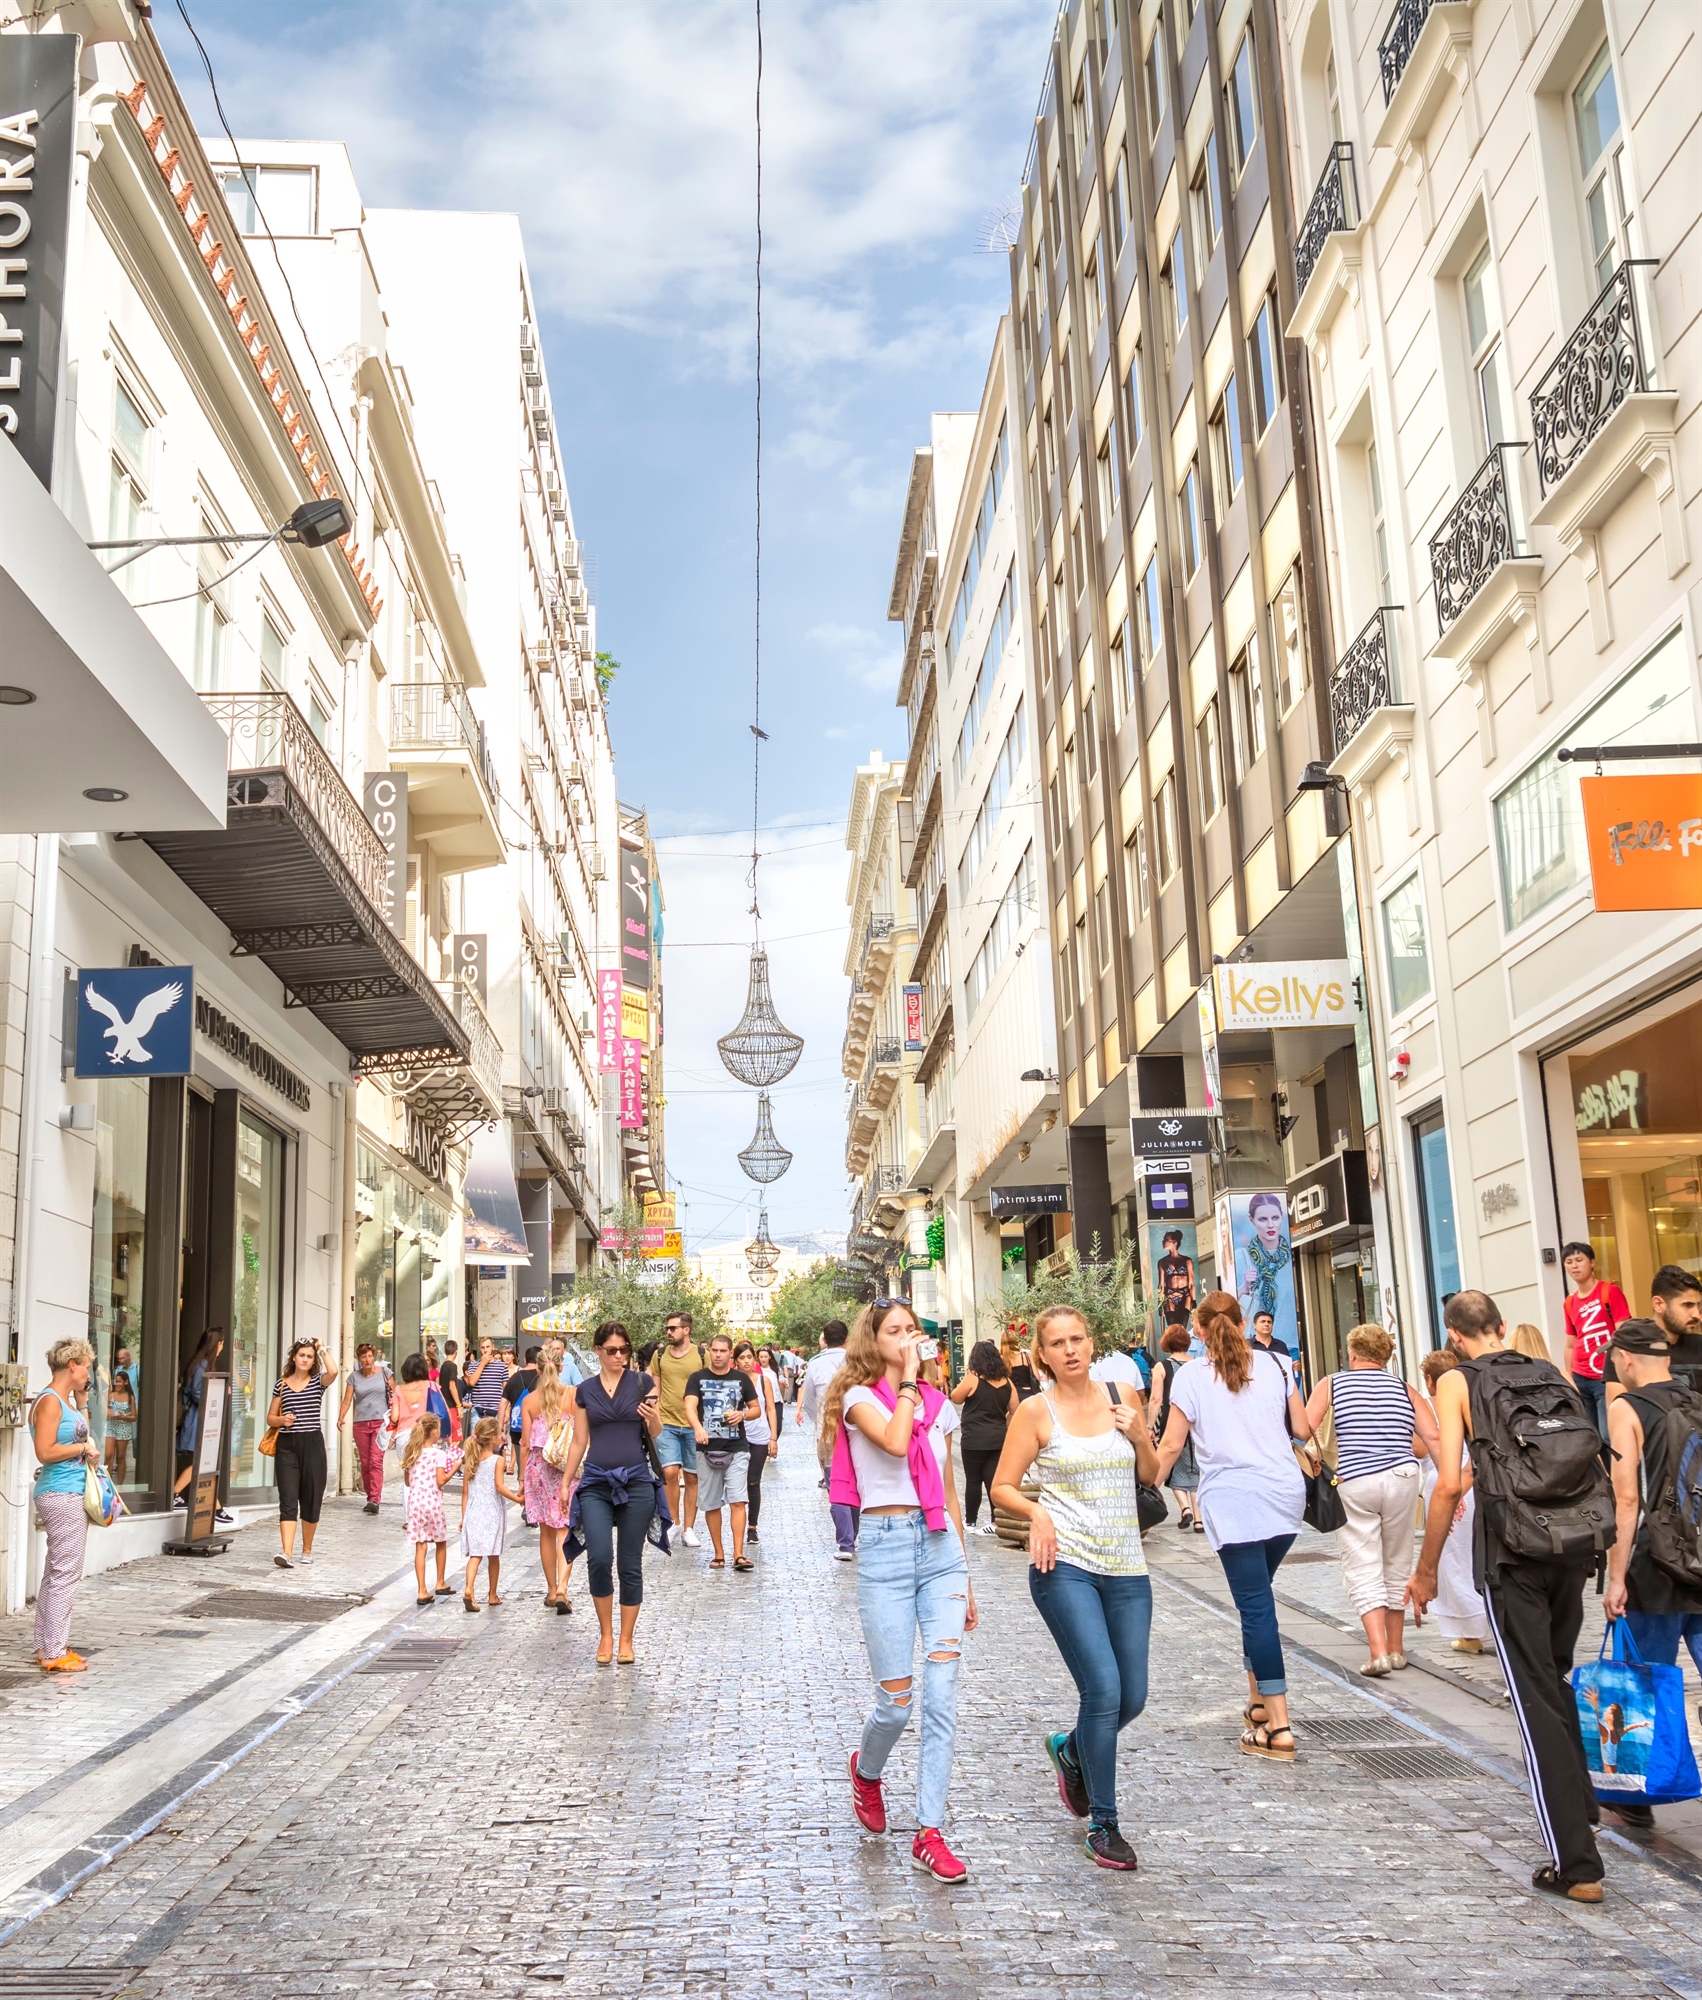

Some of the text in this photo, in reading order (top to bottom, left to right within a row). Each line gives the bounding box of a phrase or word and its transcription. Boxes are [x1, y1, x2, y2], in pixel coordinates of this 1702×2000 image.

[1608, 820, 1672, 866] Folli
[1233, 1015, 1302, 1023] ACCESSORIES
[1141, 1141, 1169, 1149] JULIA
[1146, 1161, 1189, 1172] MED
[994, 1194, 1063, 1204] intimissimi
[647, 1207, 673, 1218] ΧΡΥΣΑ
[629, 1233, 662, 1242] oman
